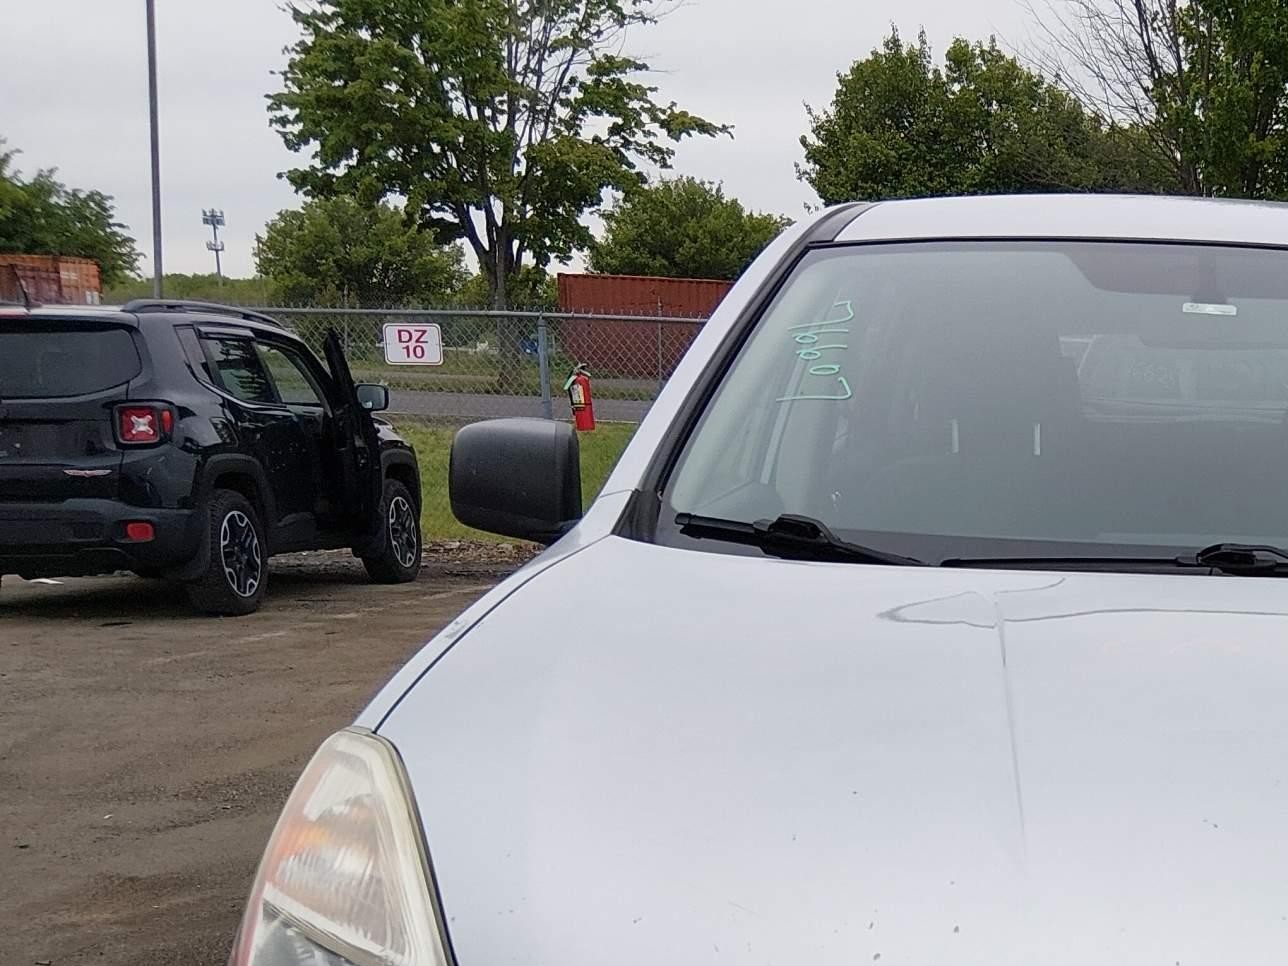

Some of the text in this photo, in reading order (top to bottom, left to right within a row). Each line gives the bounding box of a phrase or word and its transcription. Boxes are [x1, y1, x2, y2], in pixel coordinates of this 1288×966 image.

[397, 329, 428, 343] DZ
[402, 345, 425, 359] 10
[775, 299, 854, 402] 76607
